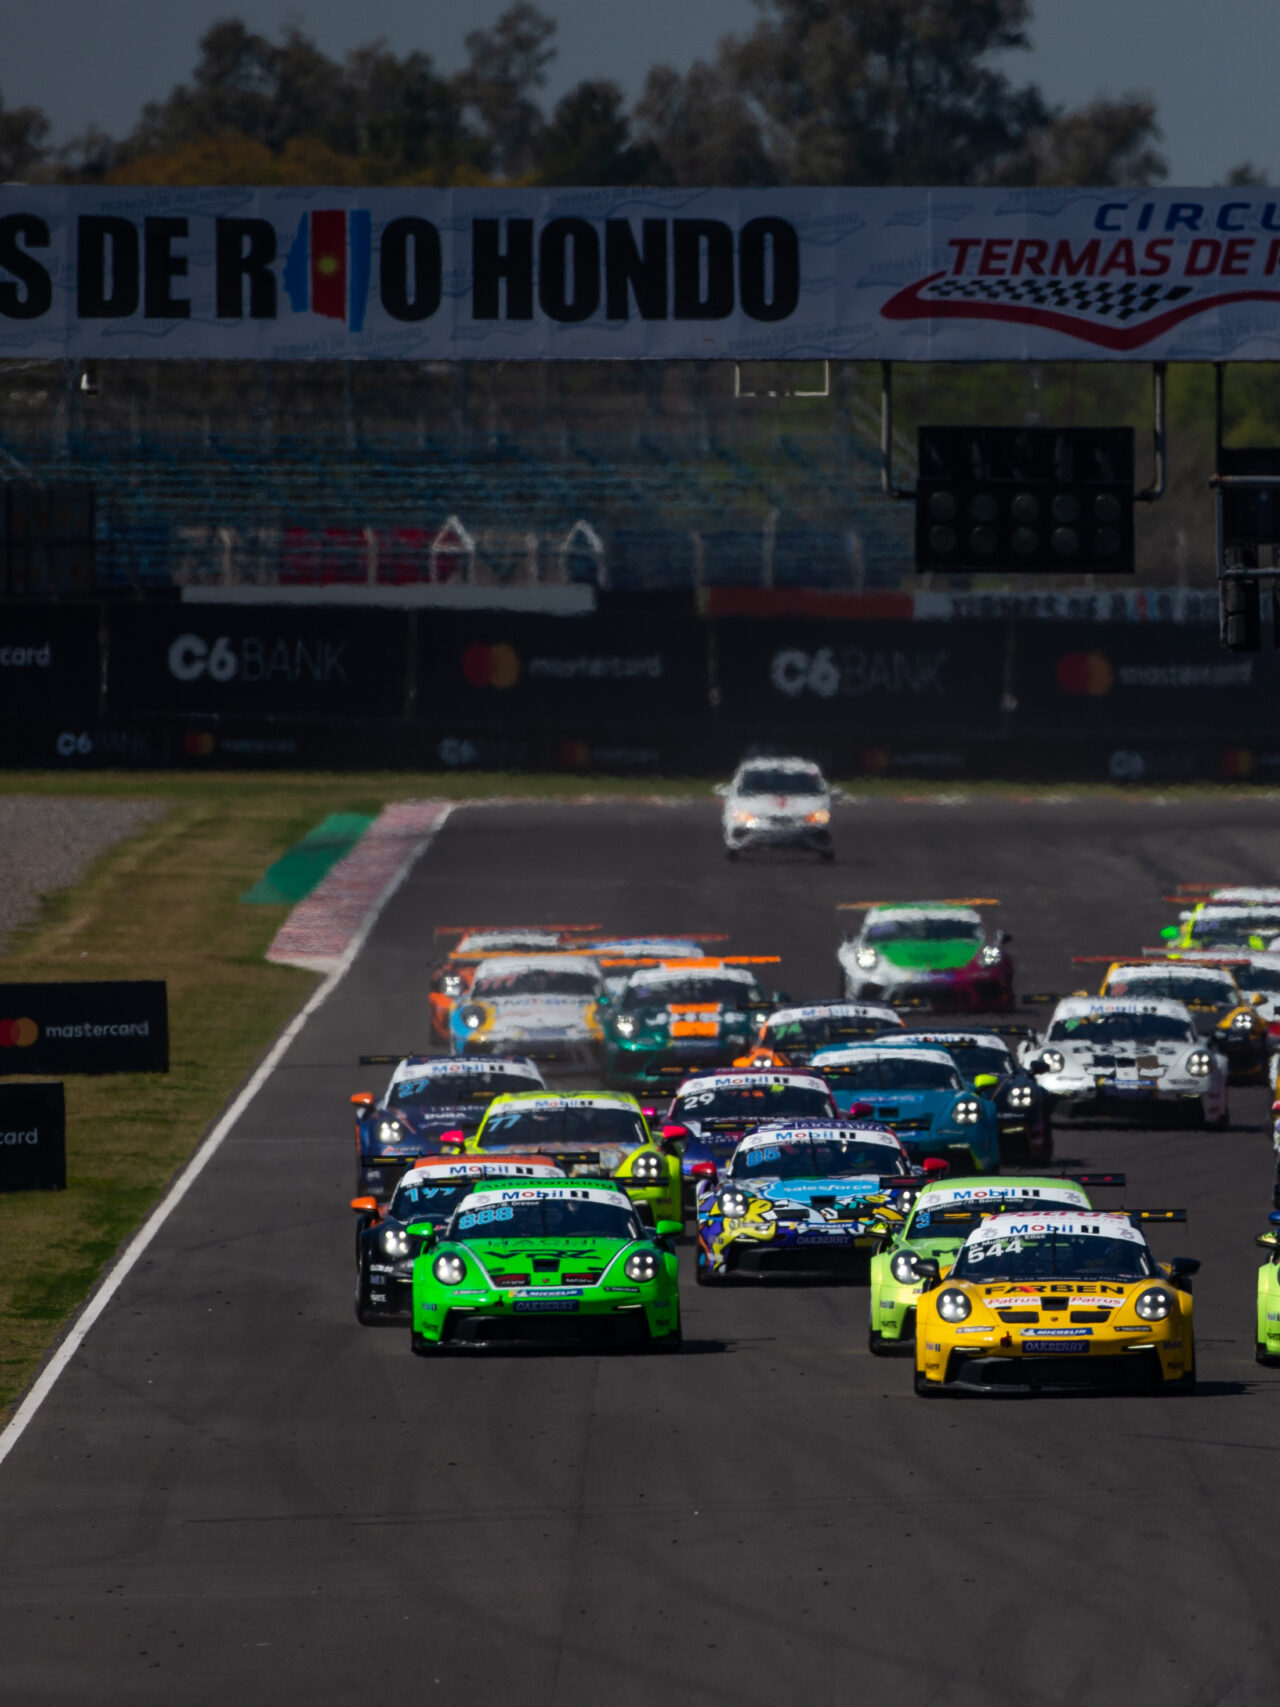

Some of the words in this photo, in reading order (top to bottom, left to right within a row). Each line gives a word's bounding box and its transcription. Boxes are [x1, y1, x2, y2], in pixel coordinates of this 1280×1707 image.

[949, 238, 1174, 276] TERMAS
[1185, 238, 1255, 276] DE
[77, 214, 191, 320] DE
[472, 215, 800, 323] HONDO
[167, 633, 237, 682] C6
[241, 637, 351, 682] BANK
[770, 647, 841, 697] C6
[45, 1019, 150, 1039] mastercard
[715, 1076, 769, 1086] Mobil
[397, 1078, 430, 1099] 27
[683, 1092, 716, 1110] 29
[776, 1131, 834, 1140] Mobil
[449, 1163, 510, 1175] Mobil
[782, 1183, 873, 1193] salesforce
[954, 1188, 1016, 1200] Mobil
[502, 1190, 564, 1201] Mobil
[459, 1206, 514, 1231] 888
[1010, 1223, 1073, 1234] Mobil
[796, 1236, 850, 1245] OAKBERRY
[967, 1239, 1024, 1264] 544
[985, 1284, 1125, 1296] FARBEN
[515, 1301, 576, 1312] OAKBERRY
[988, 1296, 1039, 1306] Patrus
[1071, 1296, 1122, 1306] Patrus
[1036, 1328, 1087, 1336] MICHELIN
[1024, 1341, 1087, 1352] OAKBERRY
